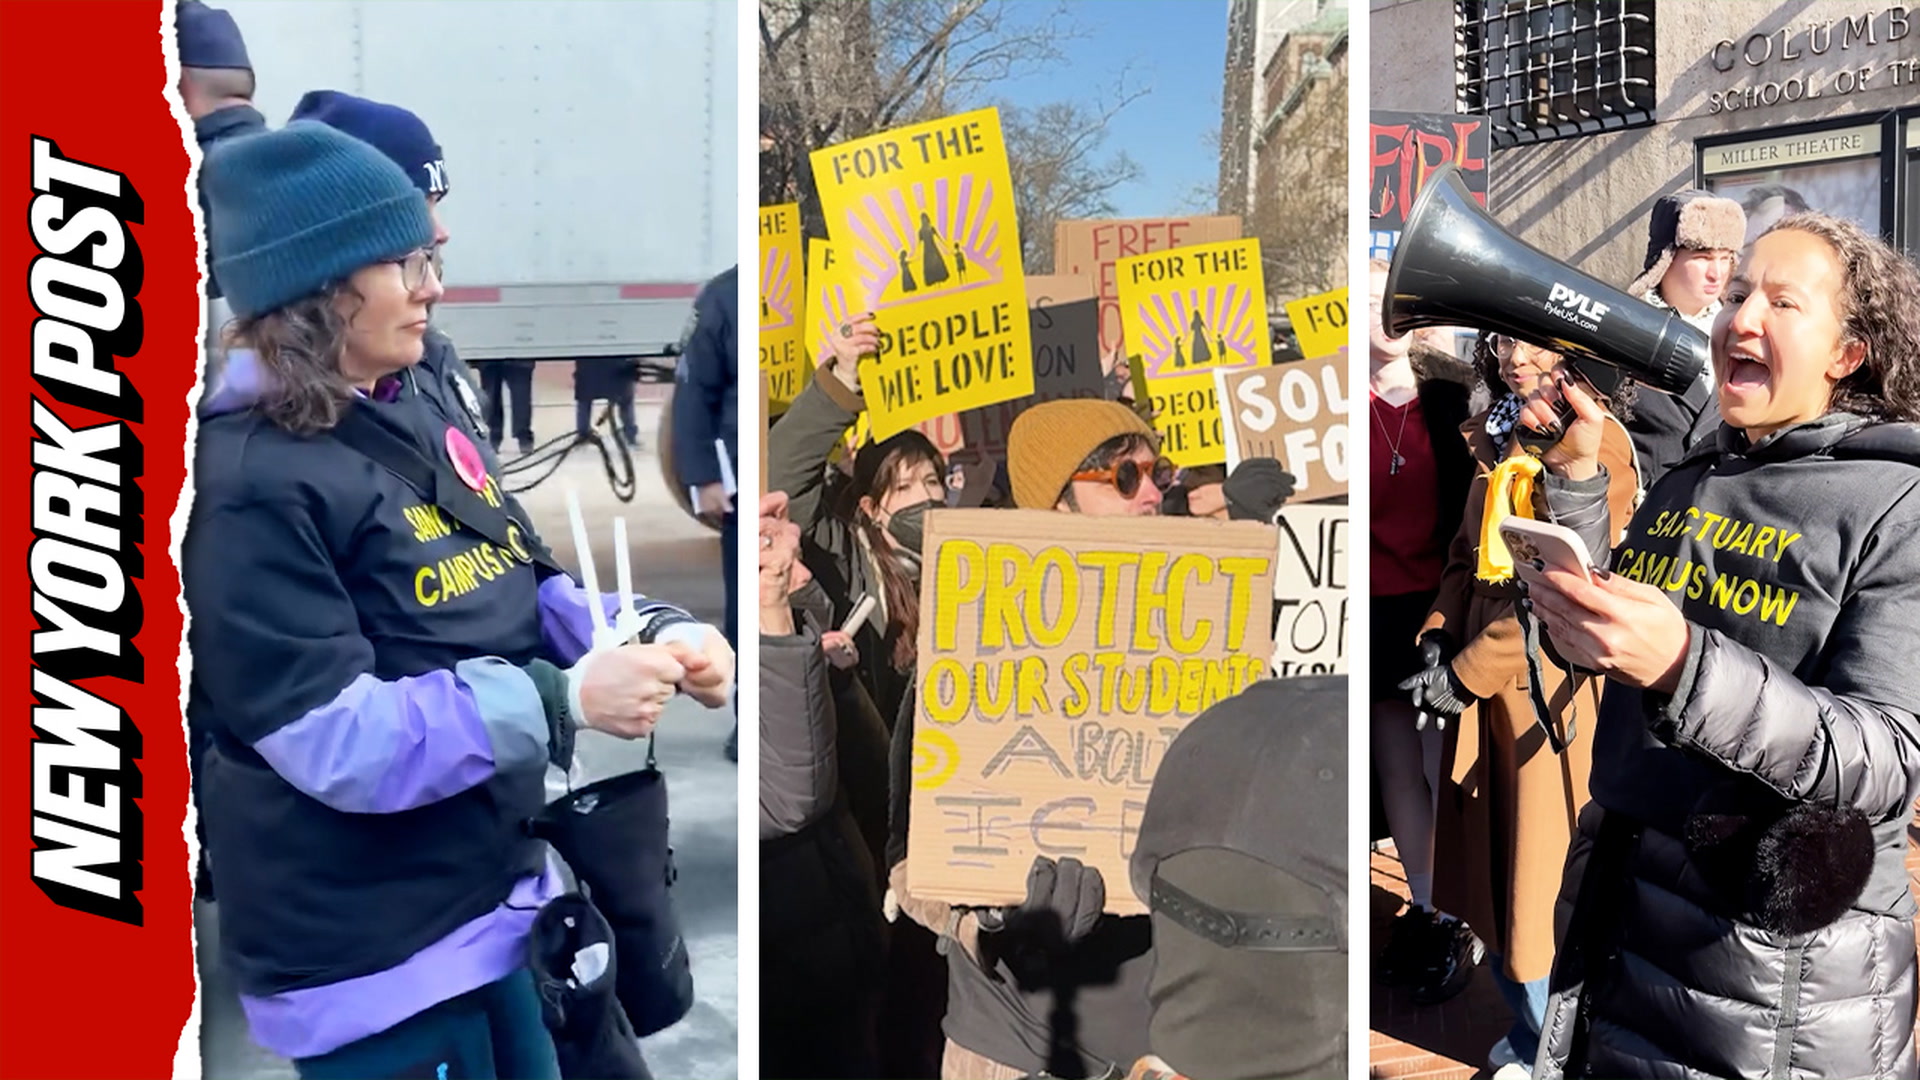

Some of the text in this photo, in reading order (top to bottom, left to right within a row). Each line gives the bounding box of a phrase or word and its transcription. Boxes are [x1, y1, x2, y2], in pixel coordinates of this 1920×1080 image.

[1709, 75, 1821, 115] SCHOOL
[1834, 66, 1873, 95] OF
[832, 122, 984, 185] FOR THE
[1721, 134, 1862, 166] MILLER THEATRE
[1131, 248, 1249, 285] FOR THE
[875, 302, 1013, 365] PEOPLE
[1543, 301, 1599, 333] PyleUSA.com
[1548, 281, 1611, 323] PYLE
[878, 342, 1016, 413] WE LOVE
[414, 542, 505, 607] CAMPUS
[933, 539, 1270, 655] PROTECT
[1616, 548, 1799, 626] CAMUS NOW
[922, 657, 1053, 725] OUR
